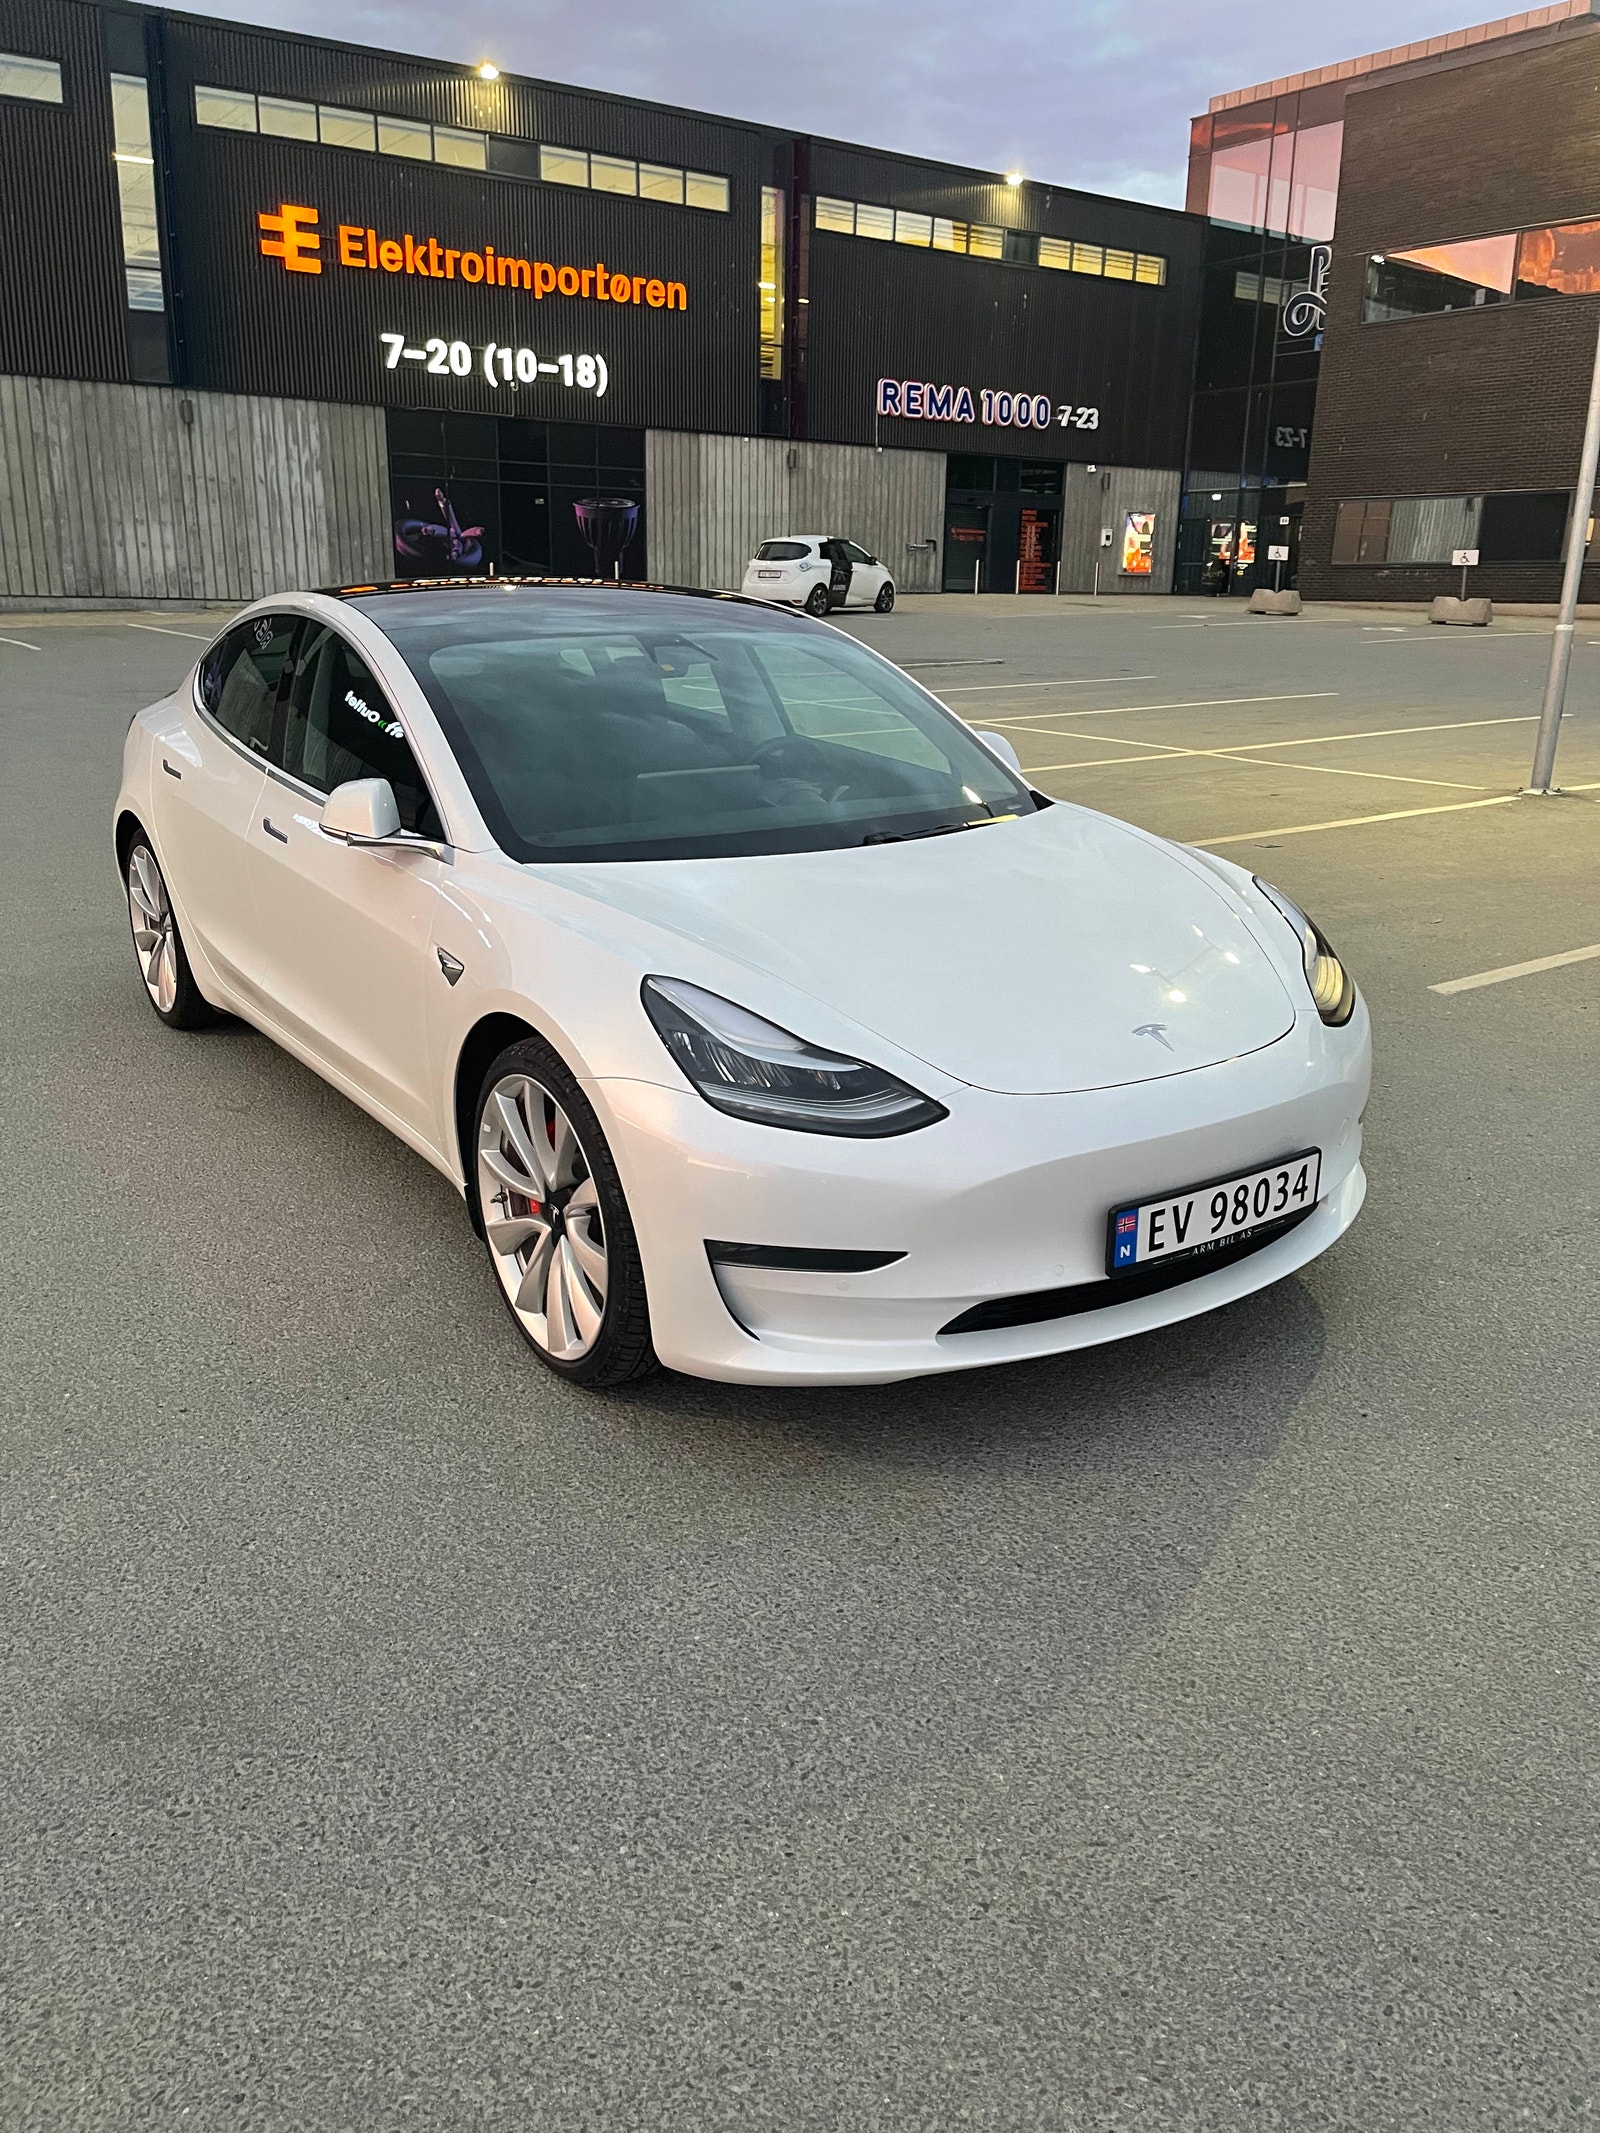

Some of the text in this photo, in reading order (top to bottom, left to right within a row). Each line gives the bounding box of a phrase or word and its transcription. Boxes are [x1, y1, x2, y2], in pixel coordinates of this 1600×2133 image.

[338, 224, 688, 311] Elektroimportøren
[877, 377, 1099, 430] REMA 1000 7-23
[1148, 1163, 1309, 1253] EV 98034
[1120, 1244, 1131, 1259] N
[1192, 1228, 1253, 1256] ARM BIL AS
